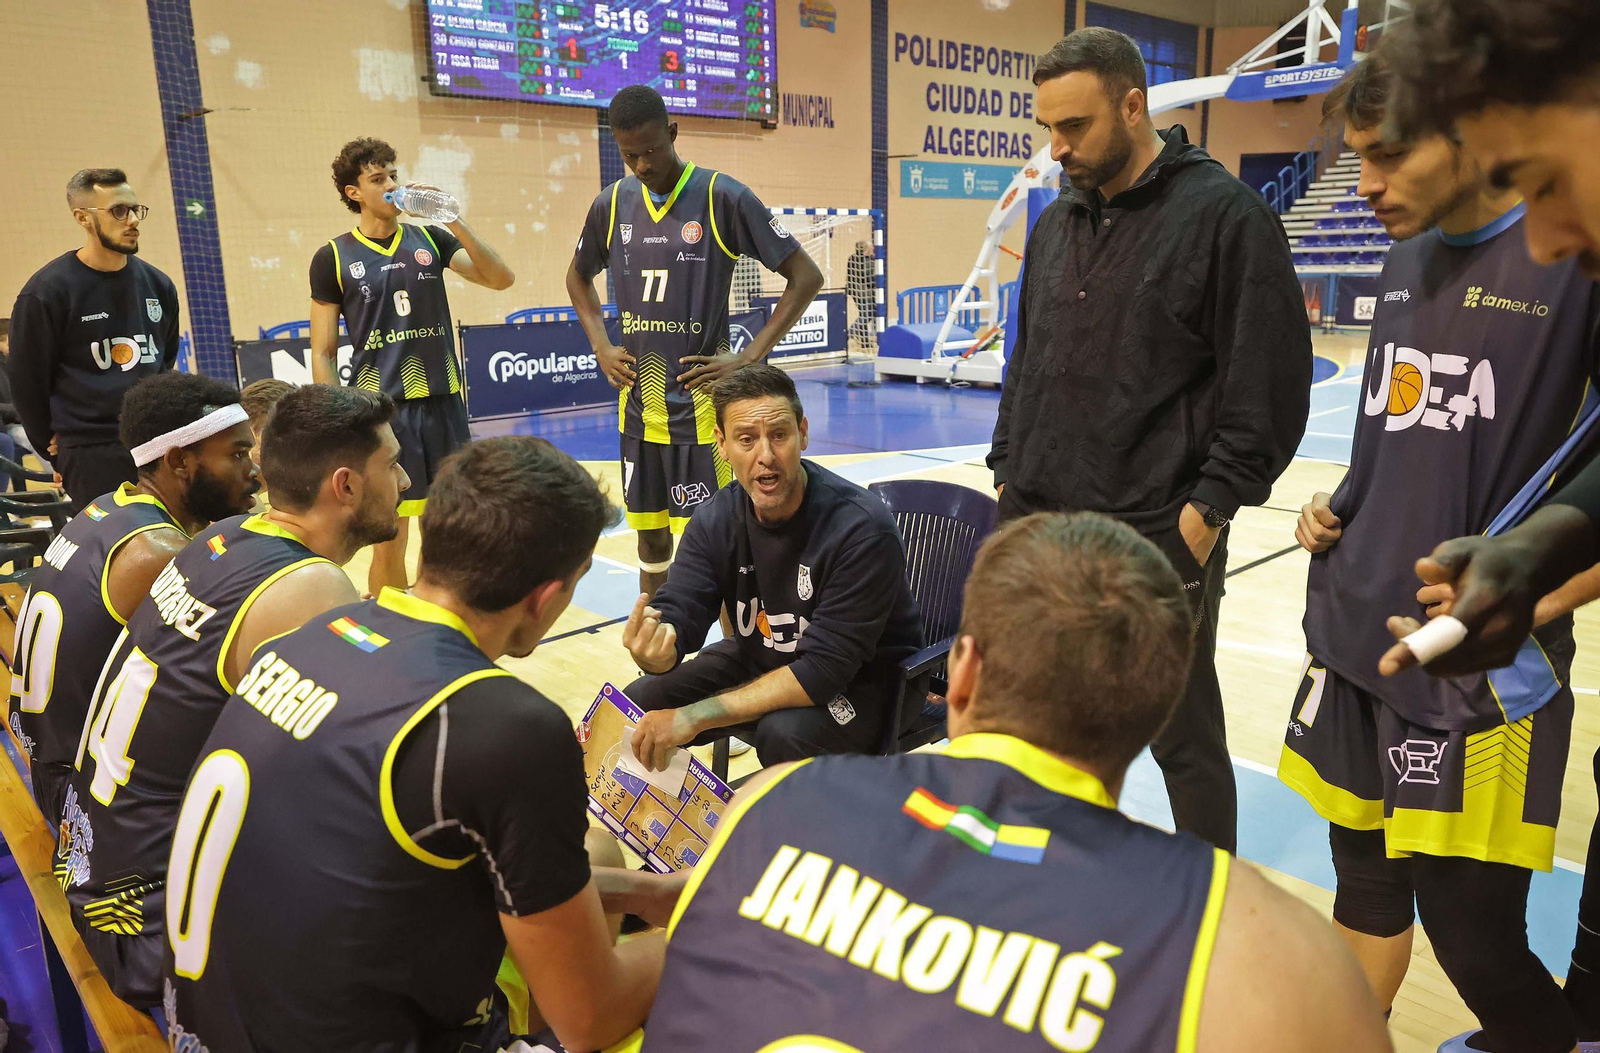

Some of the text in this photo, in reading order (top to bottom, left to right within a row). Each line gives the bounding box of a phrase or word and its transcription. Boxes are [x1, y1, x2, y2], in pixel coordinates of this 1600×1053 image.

[432, 13, 446, 26] 22
[541, 8, 547, 21] 2
[595, 4, 649, 34] 5:16
[435, 52, 448, 65] 77
[566, 38, 577, 59] 1
[619, 52, 628, 69] 1
[666, 51, 678, 71] 3
[436, 73, 450, 86] 99
[783, 92, 835, 128] MUNICIPAL
[926, 82, 1033, 119] CIUDAD DE
[923, 125, 1032, 160] ALGECIRAS
[641, 269, 669, 302] 77
[393, 290, 412, 317] 6
[1482, 290, 1549, 317] damex.io
[386, 323, 445, 343] damex.io
[634, 314, 702, 334] damex.io
[501, 352, 597, 383] populares
[552, 372, 598, 384] de Algeciras
[1364, 342, 1496, 432] UDEA
[235, 651, 339, 740] SERGIO
[166, 749, 251, 981] 0
[738, 845, 1123, 1053] JANKOVIĆ
